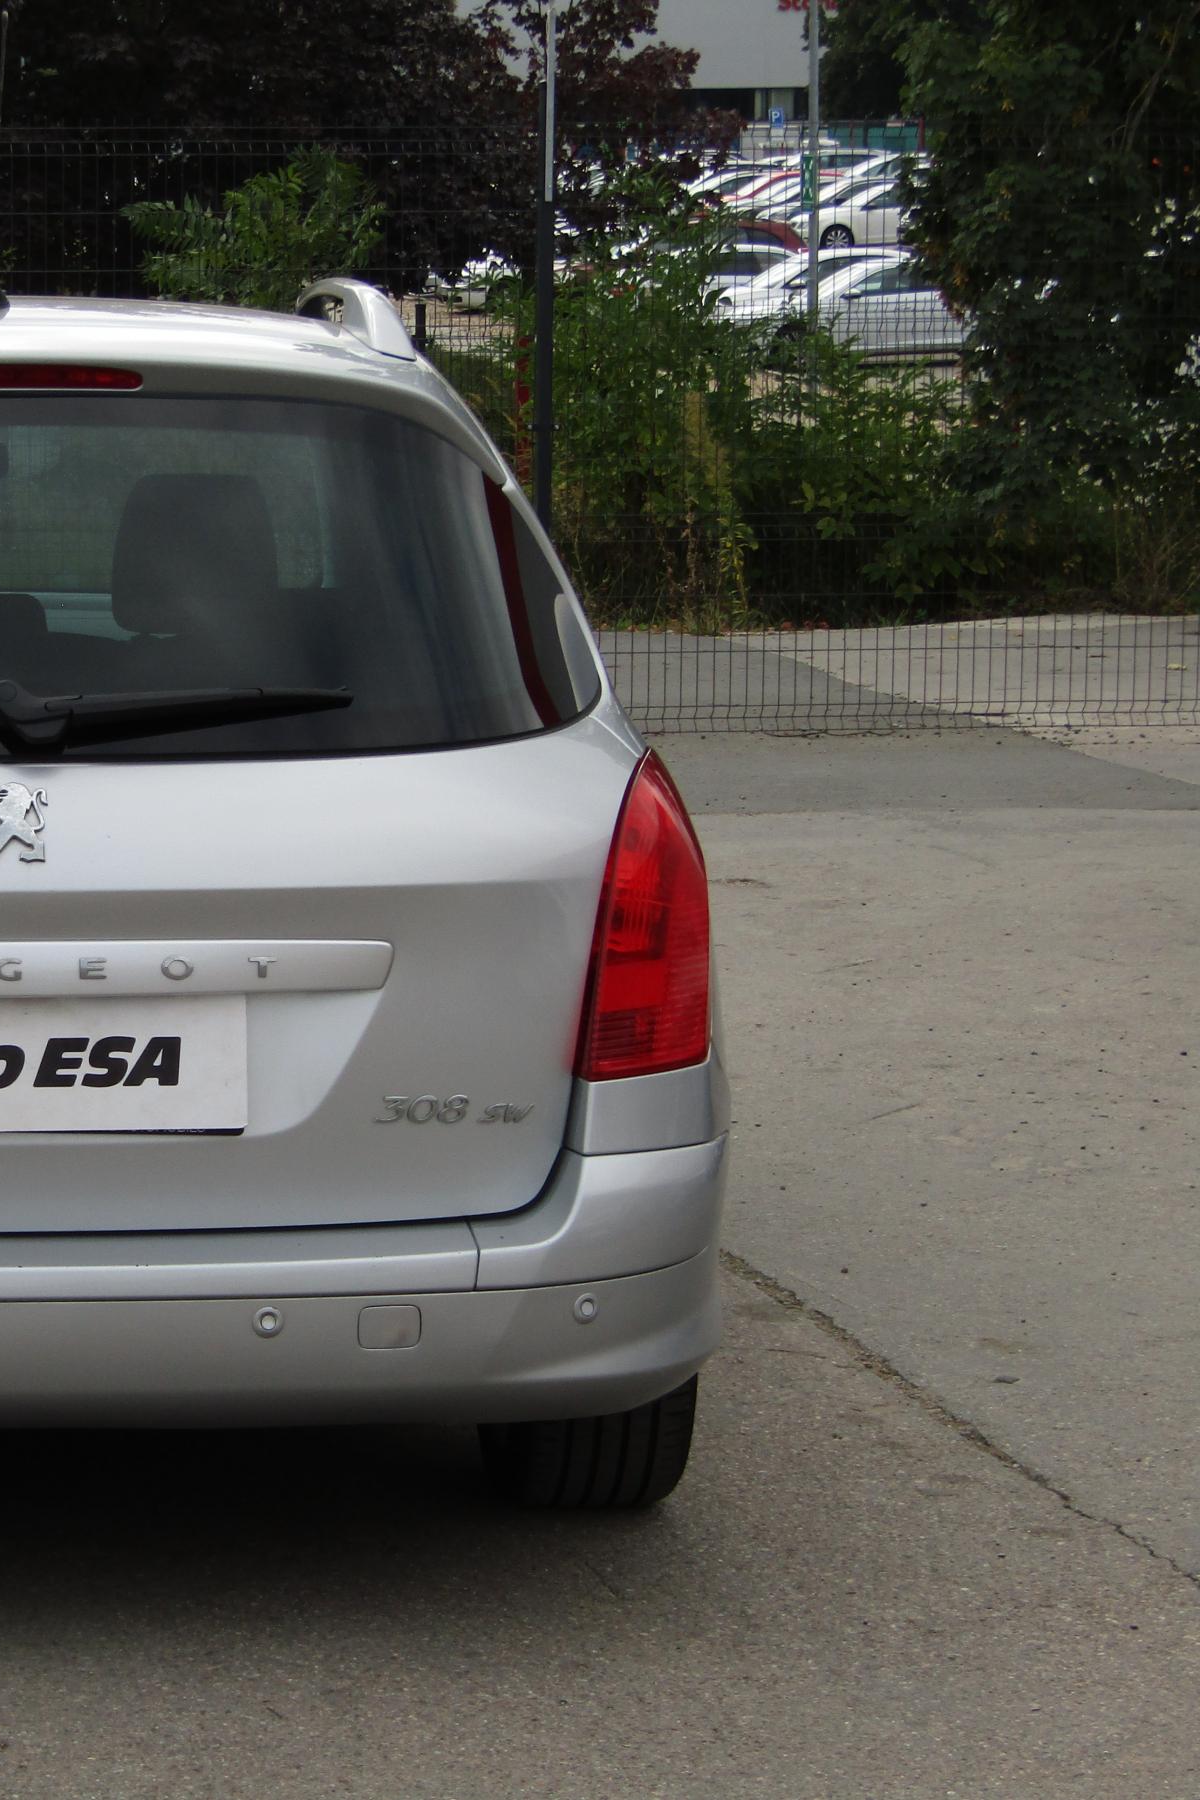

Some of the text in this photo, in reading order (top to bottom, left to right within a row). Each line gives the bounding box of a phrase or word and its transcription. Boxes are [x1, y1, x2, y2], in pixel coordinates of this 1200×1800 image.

[32, 1035, 182, 1088] ESA
[373, 1094, 535, 1124] 308 SW
